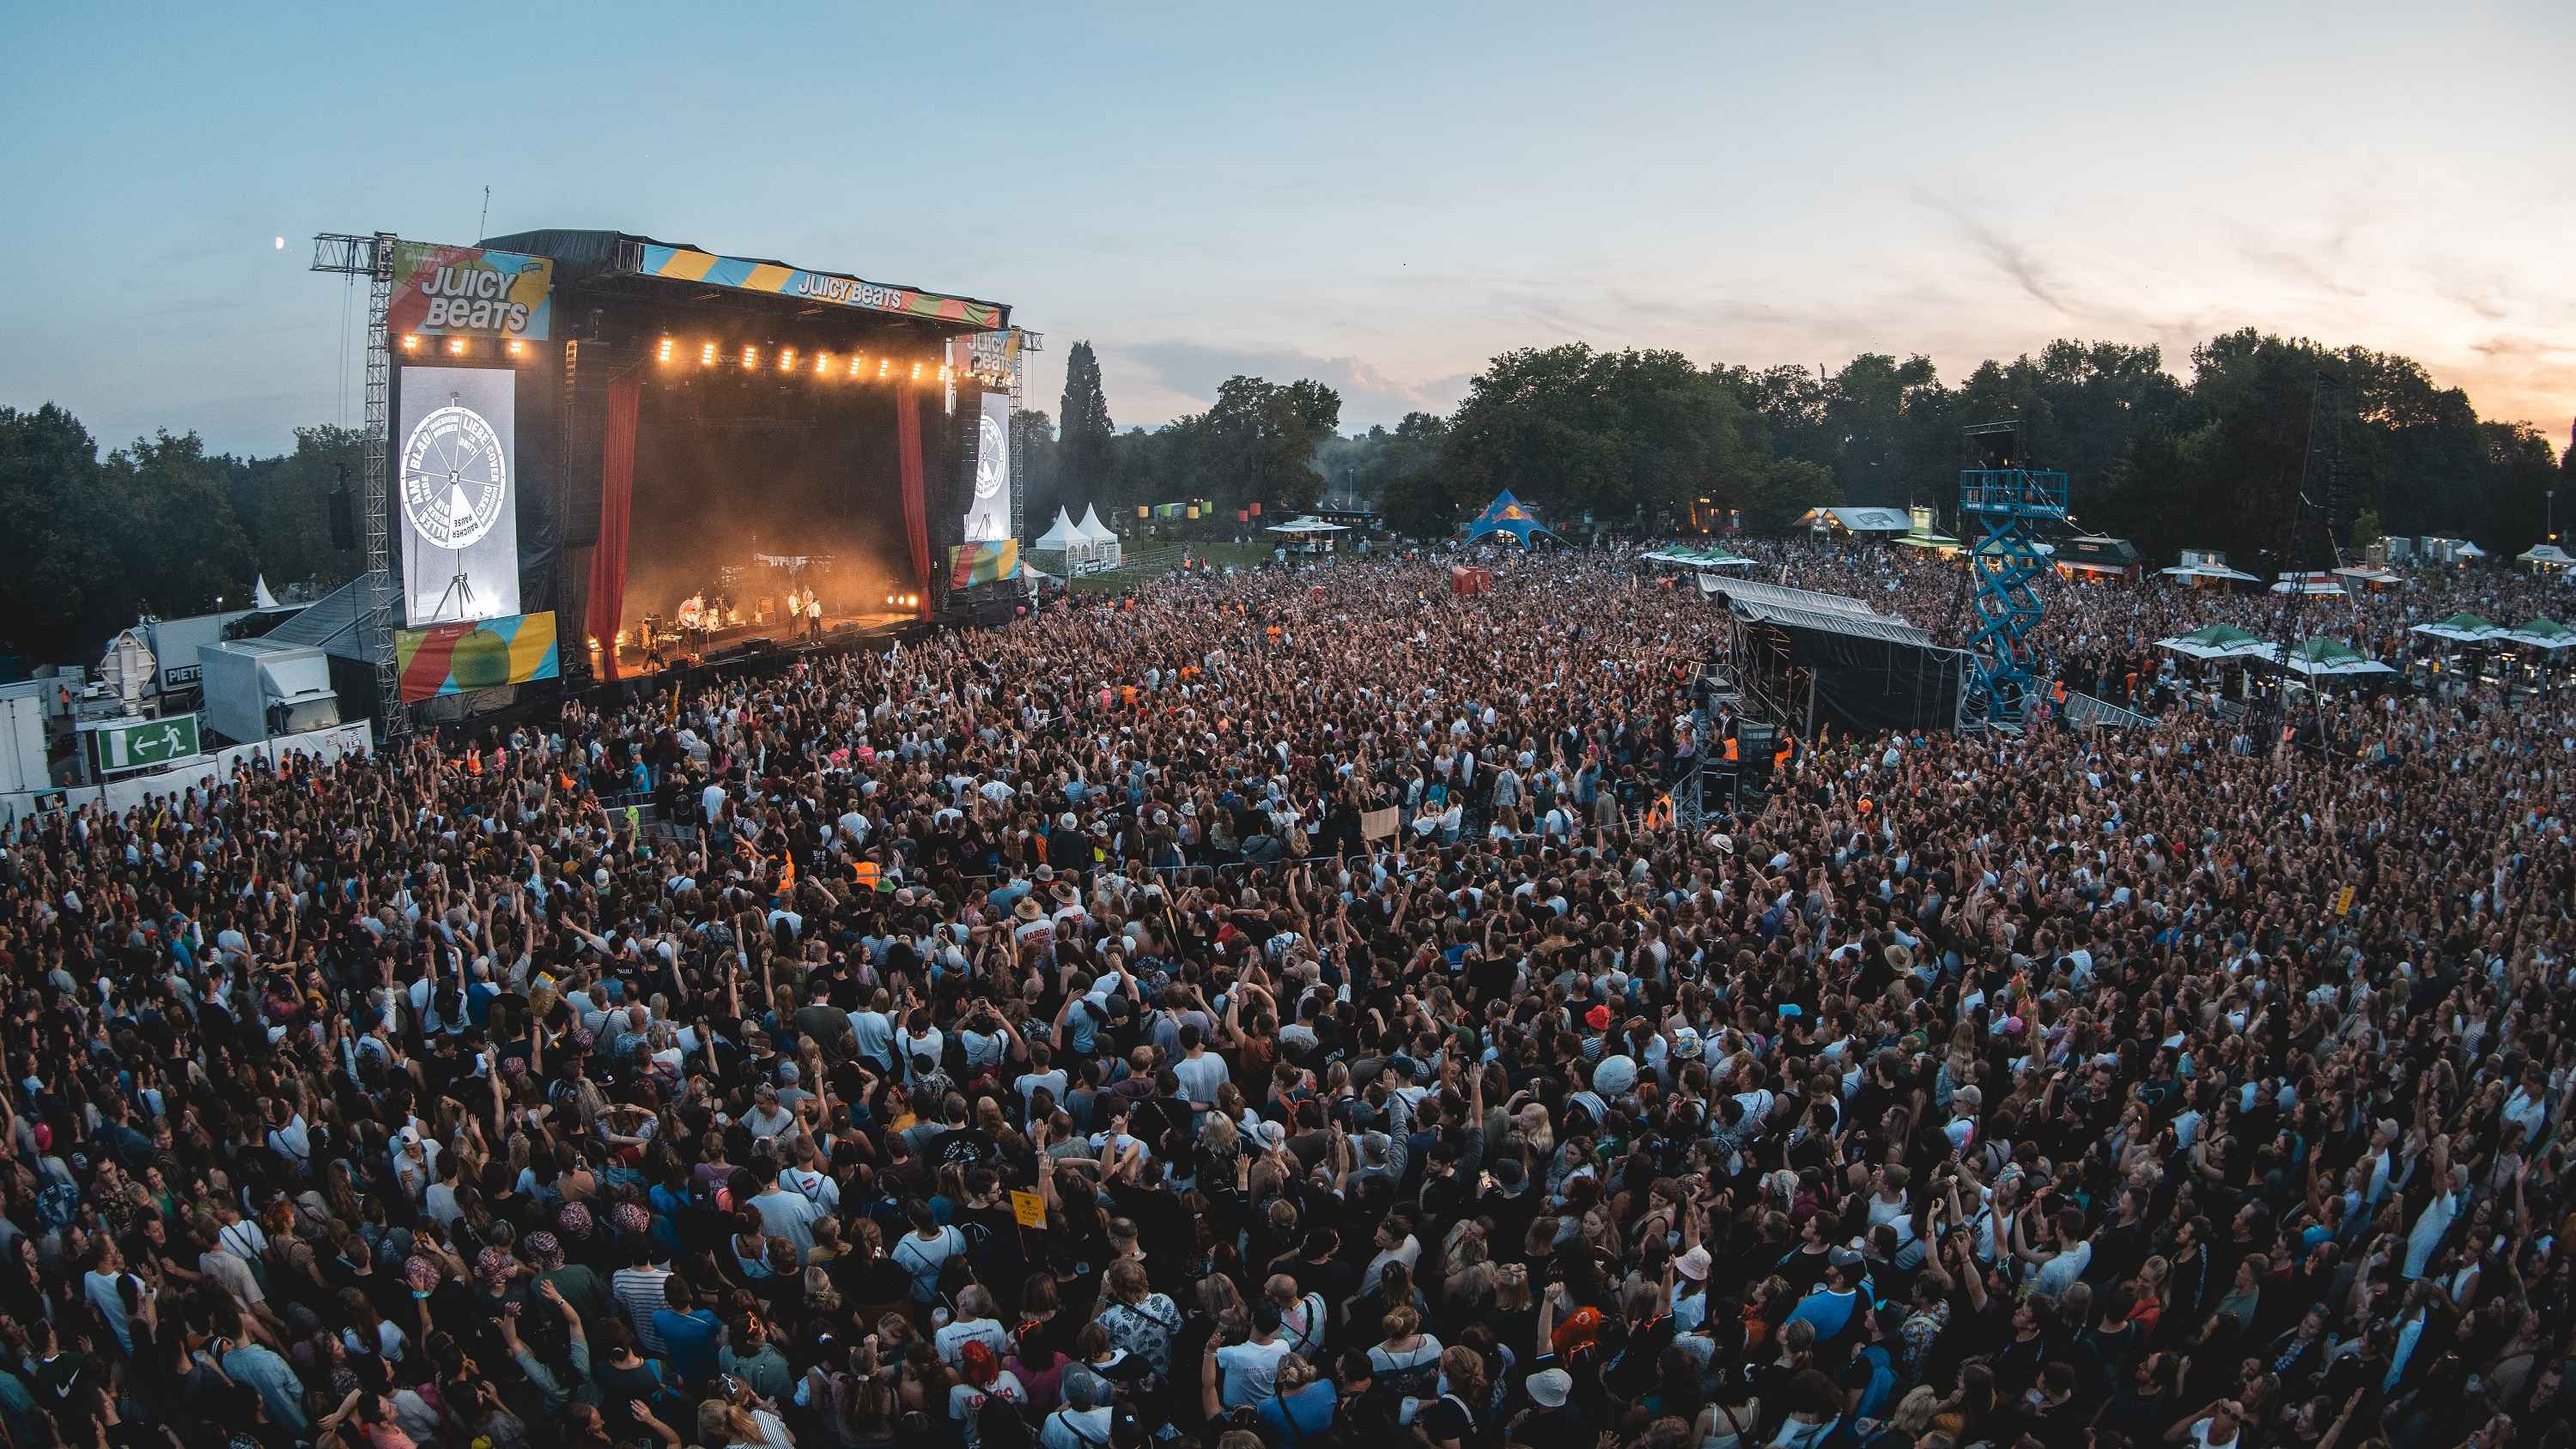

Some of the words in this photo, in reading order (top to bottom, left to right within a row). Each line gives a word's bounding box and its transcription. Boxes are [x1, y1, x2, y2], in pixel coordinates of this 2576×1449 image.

[421, 265, 518, 300] JUICY
[798, 274, 850, 300] JUICY
[462, 416, 490, 446] LIEBE
[410, 430, 432, 470] BLAU
[485, 445, 499, 482] COVER
[409, 479, 424, 505] AM
[419, 510, 449, 539] ALLES
[452, 521, 479, 538] RAUCHER
[454, 513, 472, 528] PAUSE
[1023, 928, 1050, 942] KARGO
